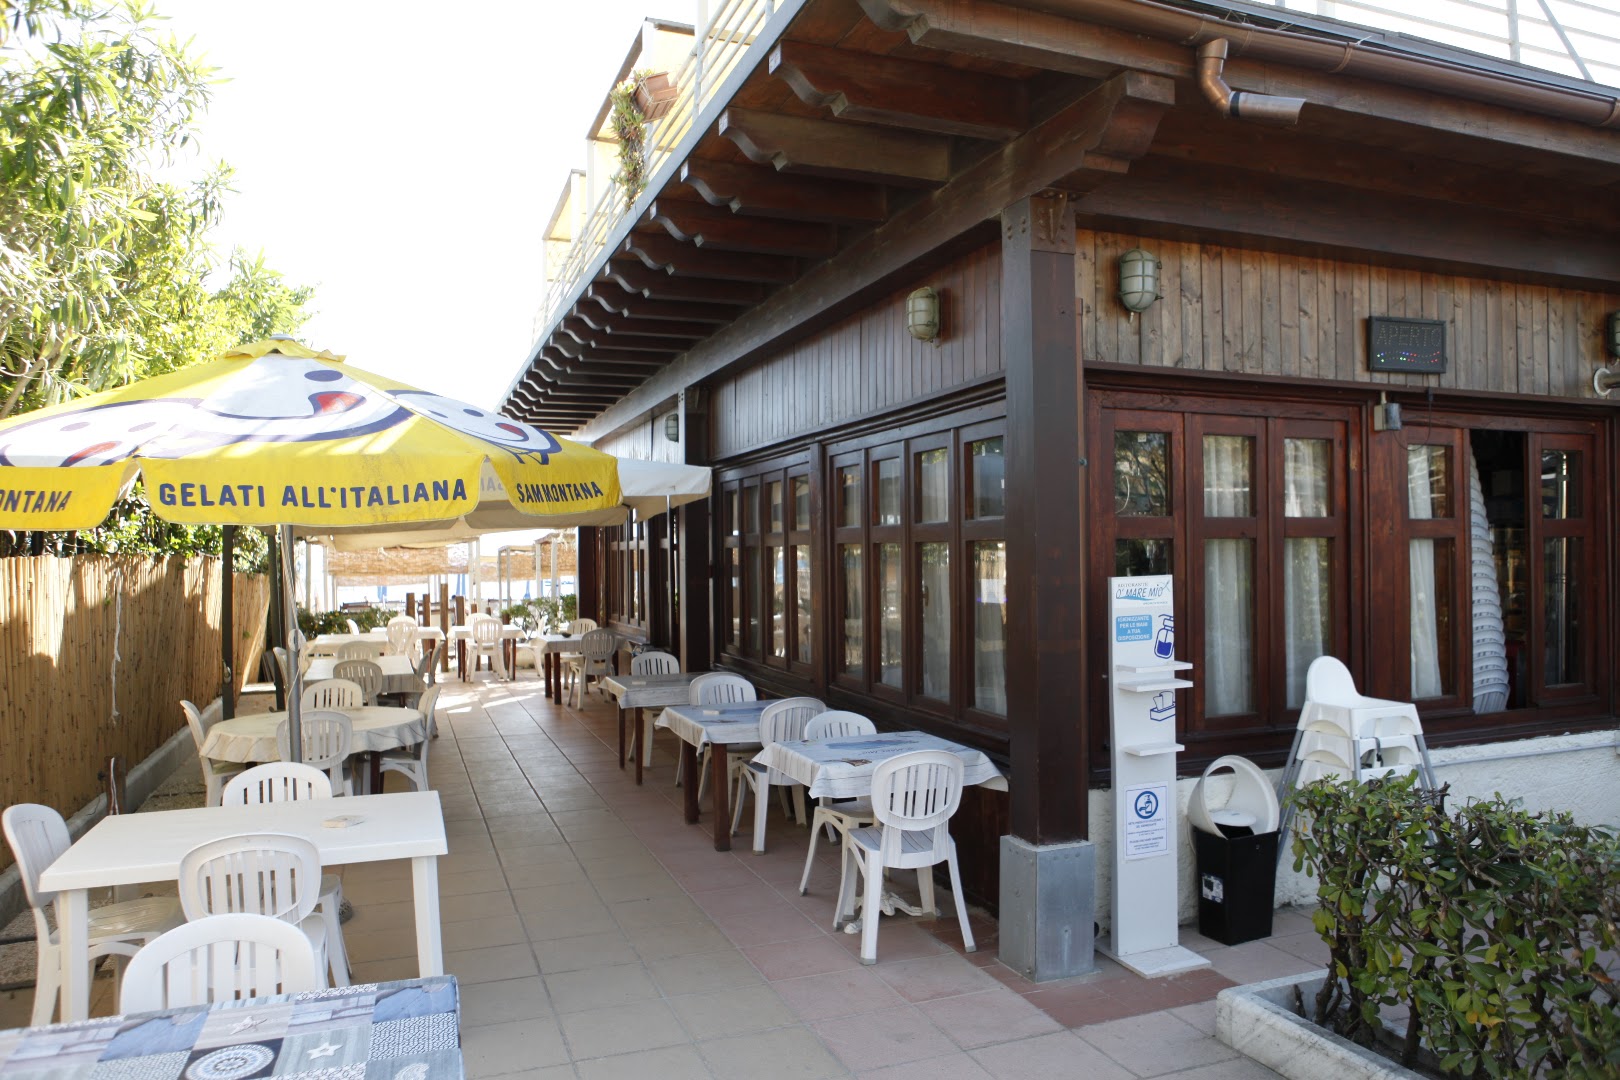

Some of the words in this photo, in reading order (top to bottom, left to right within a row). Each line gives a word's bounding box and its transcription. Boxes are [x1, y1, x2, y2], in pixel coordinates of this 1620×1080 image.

[1377, 325, 1441, 346] APERTO
[159, 482, 265, 507] GELATI
[282, 478, 467, 509] ALL'ITALIANA
[516, 481, 604, 503] SAMMONTANA
[1126, 588, 1147, 597] MARE
